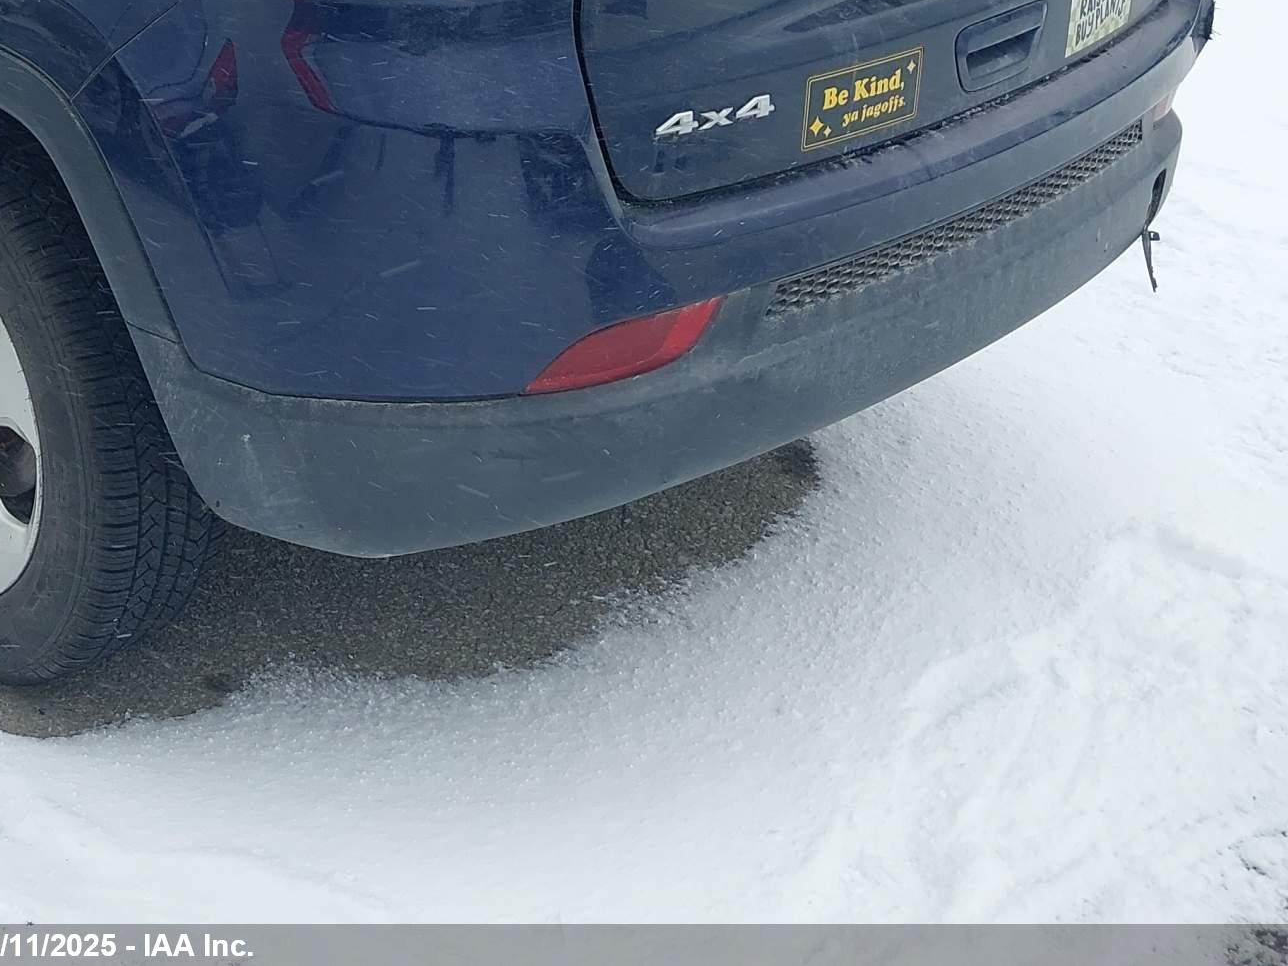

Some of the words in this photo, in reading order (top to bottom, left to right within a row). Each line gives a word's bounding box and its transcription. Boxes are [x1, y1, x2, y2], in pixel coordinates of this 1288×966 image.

[1075, 12, 1094, 47] BUY
[822, 86, 849, 111] Be
[853, 68, 905, 102] Kind,
[655, 94, 775, 135] 4x4
[842, 110, 859, 127] ya
